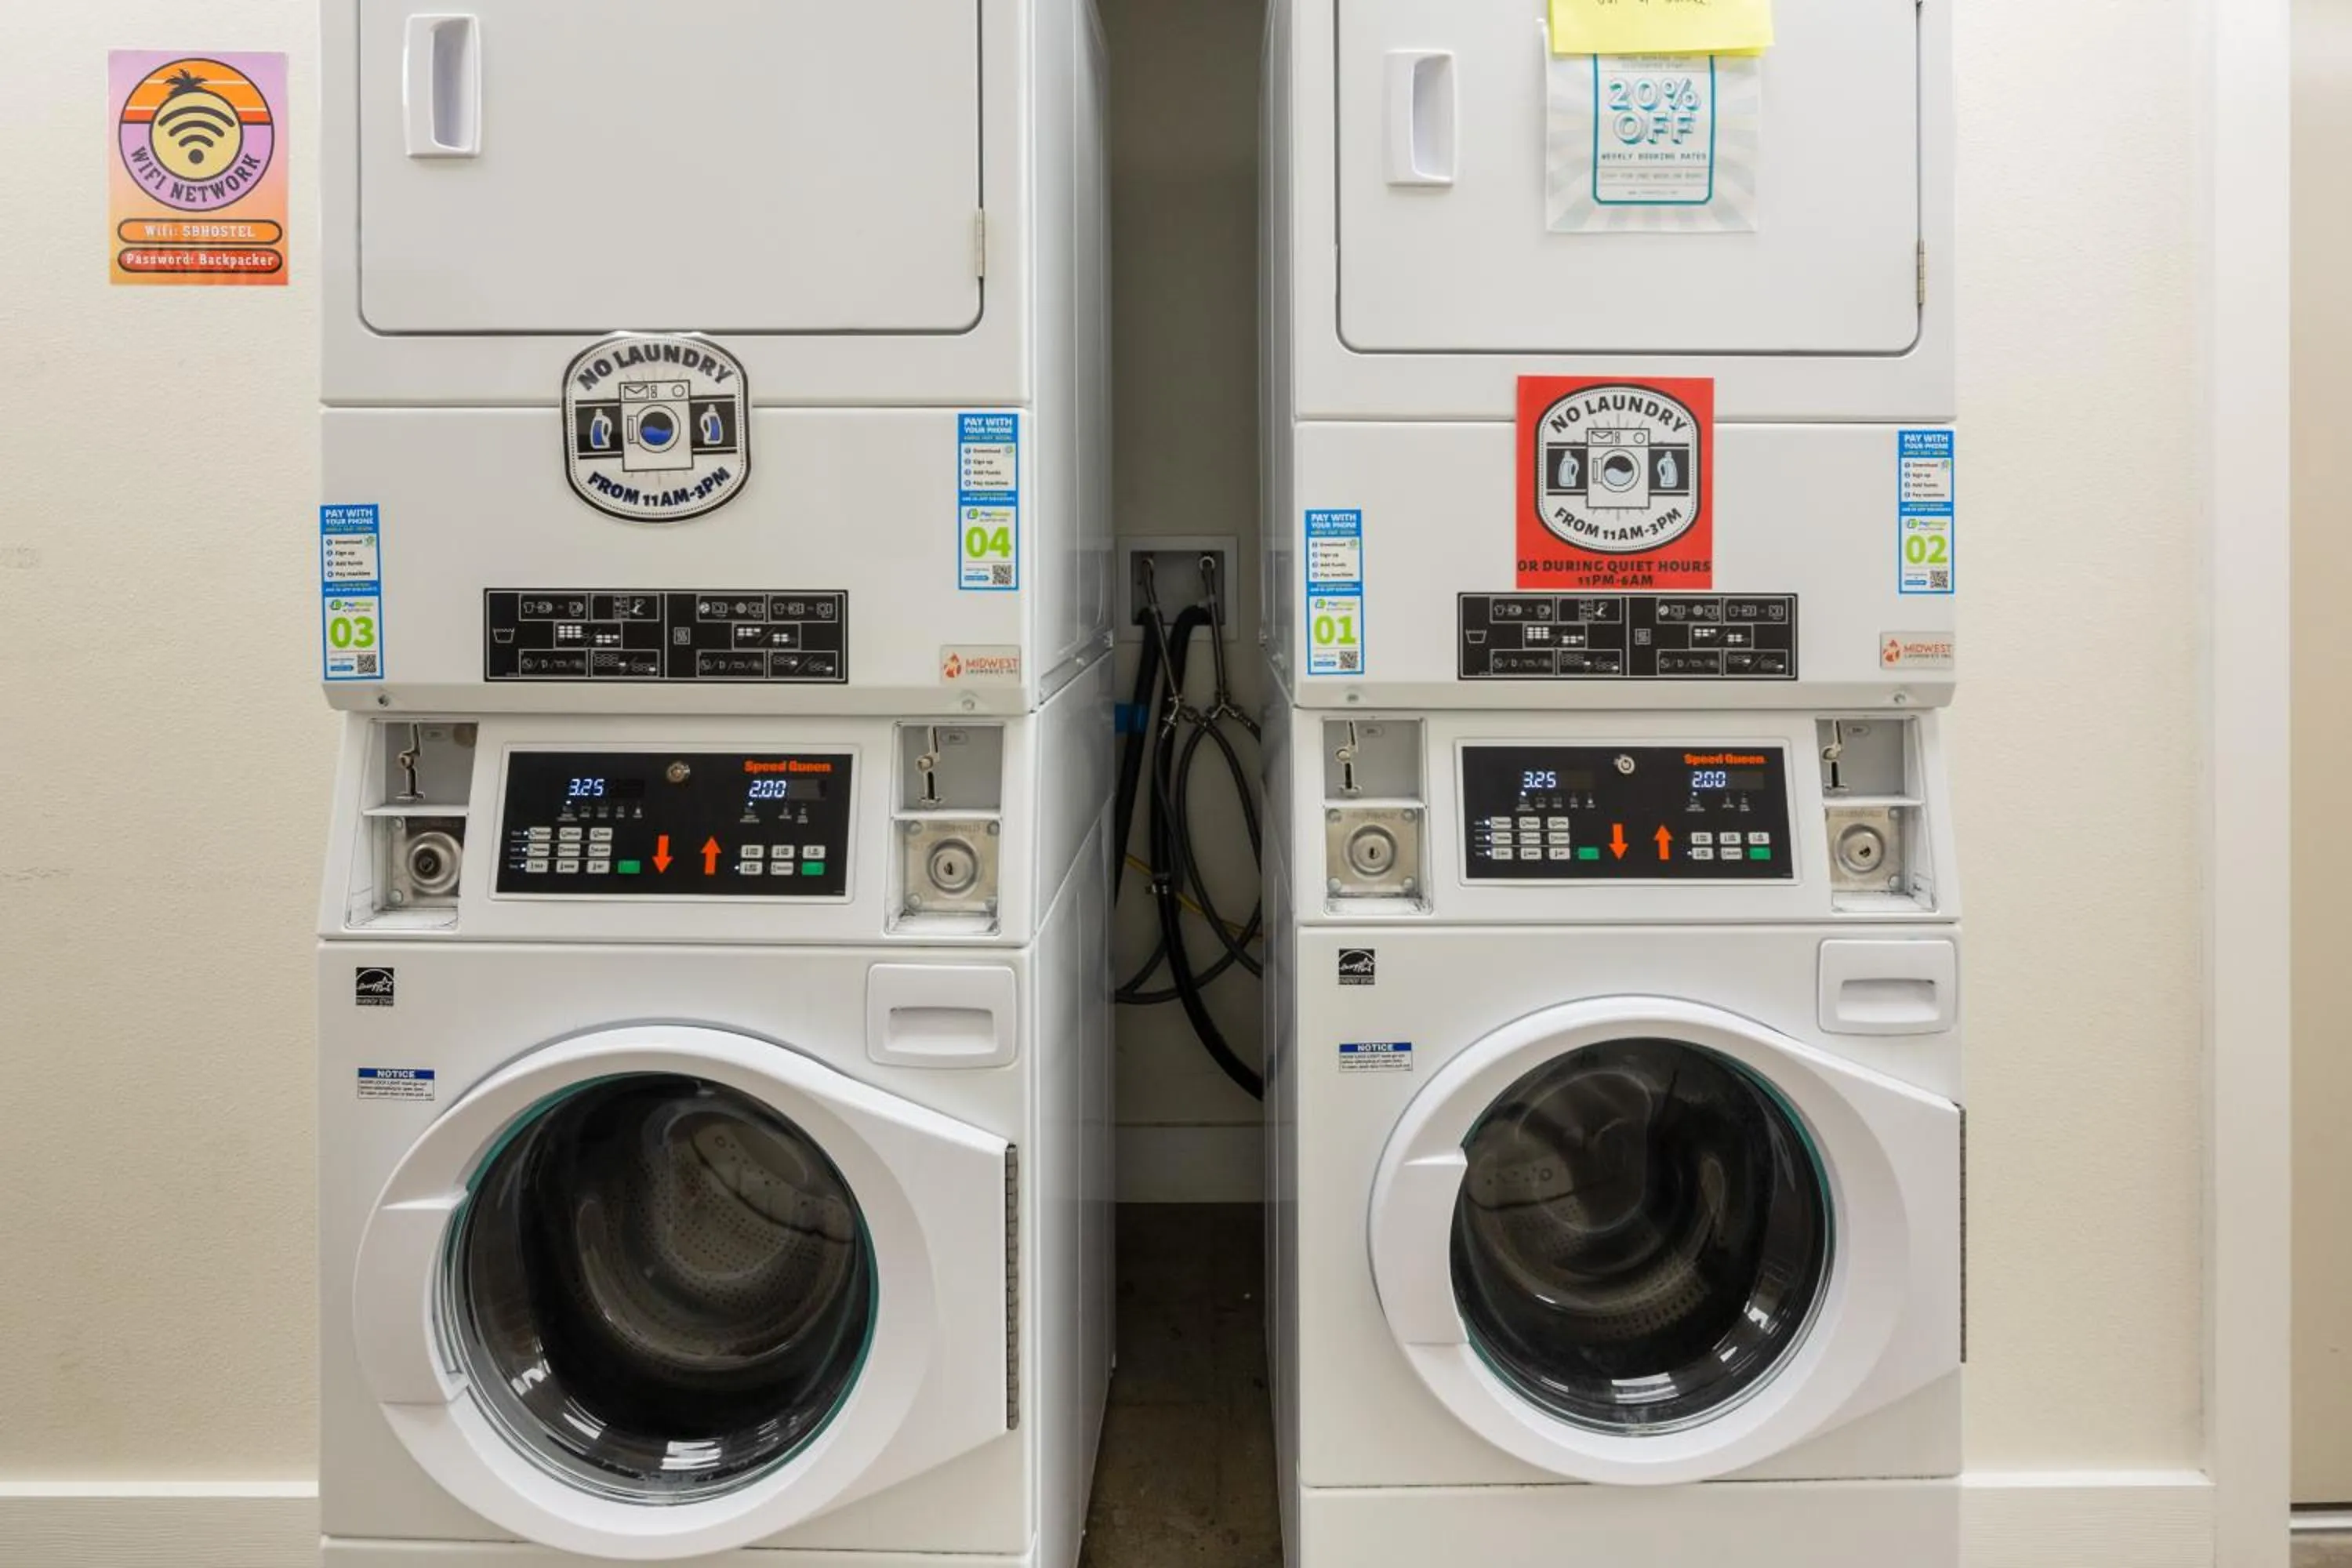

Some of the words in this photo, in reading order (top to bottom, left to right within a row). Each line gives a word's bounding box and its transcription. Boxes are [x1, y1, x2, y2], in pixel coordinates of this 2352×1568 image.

[1608, 78, 1701, 111] 20%
[1613, 112, 1697, 145] OFF
[130, 146, 167, 191] WIFI
[170, 153, 262, 203] NETWORK
[144, 224, 178, 238] Wifi:
[182, 225, 255, 238] SBHOSTEL
[125, 253, 196, 265] Password:
[199, 253, 274, 268] Backpacker
[577, 358, 613, 391] NO
[612, 344, 734, 384] LAUNDRY
[1550, 406, 1581, 434] NO
[1584, 394, 1688, 433] LAUNDRY
[588, 471, 640, 506] FROM
[642, 465, 731, 507] 11AM-3PM
[326, 509, 343, 517] PAY
[347, 509, 373, 517] WITH
[1554, 507, 1599, 538] FROM
[1603, 508, 1682, 541] 11AM-3PM
[966, 527, 1011, 558] 04
[1906, 535, 1948, 564] 02
[1518, 561, 1538, 572] OR
[1543, 561, 1604, 572] DURING
[1608, 561, 1653, 572] QUIET
[1658, 561, 1711, 572] HOURS
[1578, 575, 1653, 586] 11PM-6AM
[330, 616, 375, 648] 03
[1314, 615, 1356, 646] 01
[1904, 644, 1953, 652] MIDWEST
[966, 658, 1019, 668] MIDWEST
[745, 760, 787, 774] Speed
[789, 760, 832, 773] Queen
[1683, 753, 1724, 765] Speed
[1725, 753, 1766, 764] Queen
[1692, 771, 1726, 788] 2.00
[749, 780, 787, 798] 2.00
[376, 1070, 416, 1079] NOTICE
